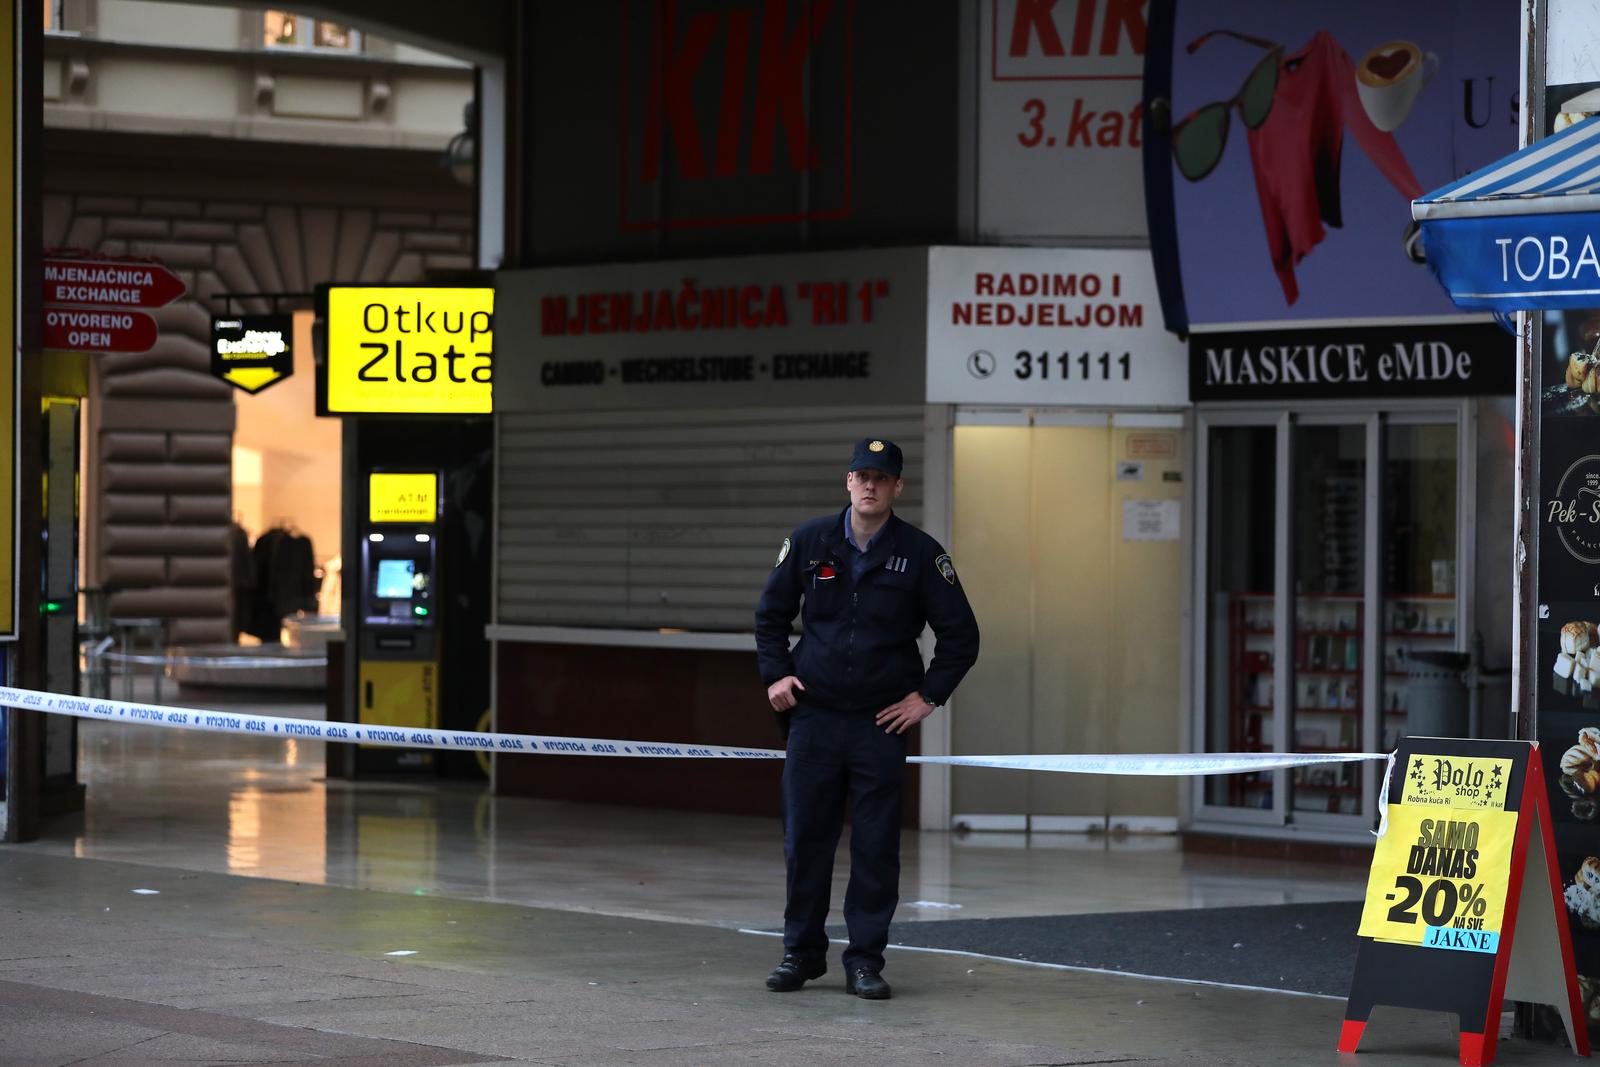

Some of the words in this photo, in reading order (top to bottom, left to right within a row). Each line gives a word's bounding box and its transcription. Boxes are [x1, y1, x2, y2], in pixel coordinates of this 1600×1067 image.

[640, 0, 832, 183] KIK
[1018, 98, 1056, 148] 3.
[1066, 98, 1143, 148] kat
[1495, 234, 1600, 283] TOBA
[975, 273, 1100, 297] RADIMO
[1112, 274, 1120, 297] I
[56, 286, 141, 303] EXCHANGE
[540, 278, 787, 336] MJENJAČNICA
[796, 281, 848, 325] "RI
[857, 279, 890, 323] 1"
[952, 303, 1143, 328] NEDJELJOM
[47, 312, 133, 330] OTVORENO
[363, 302, 491, 343] Otkup
[68, 331, 111, 346] OPEN
[358, 340, 493, 383] Zlata
[621, 356, 754, 383] WECHSELSTUBE
[773, 351, 870, 379] EXCHANGE
[1014, 351, 1131, 380] 311111
[1205, 344, 1368, 386] MASKICE
[1378, 342, 1472, 380] eMDe
[1548, 499, 1600, 524] Pek-S
[94, 704, 114, 715] STOP
[130, 708, 164, 721] POLICIJA
[168, 713, 188, 724] STOP
[206, 716, 240, 729] POLICIJA
[245, 720, 266, 731] STOP
[285, 723, 321, 736] POLICIJA
[327, 727, 347, 738] STOP
[367, 729, 405, 742] POLICIJA
[411, 733, 434, 745] STOP
[453, 736, 493, 748] POLICIJA
[500, 738, 523, 749] STOP
[543, 741, 586, 753] POLICIJA
[592, 745, 616, 753] STOP
[636, 746, 680, 756] POLICIJA
[1432, 759, 1484, 791] Polo
[1408, 795, 1428, 804] Robna
[1456, 786, 1480, 798] shop
[1418, 819, 1479, 852] SAMO
[1407, 845, 1479, 879] DANAS
[1386, 875, 1486, 926] -20%
[1453, 916, 1465, 929] NA
[1467, 918, 1484, 930] SVE
[1430, 929, 1491, 950] JAKNE
